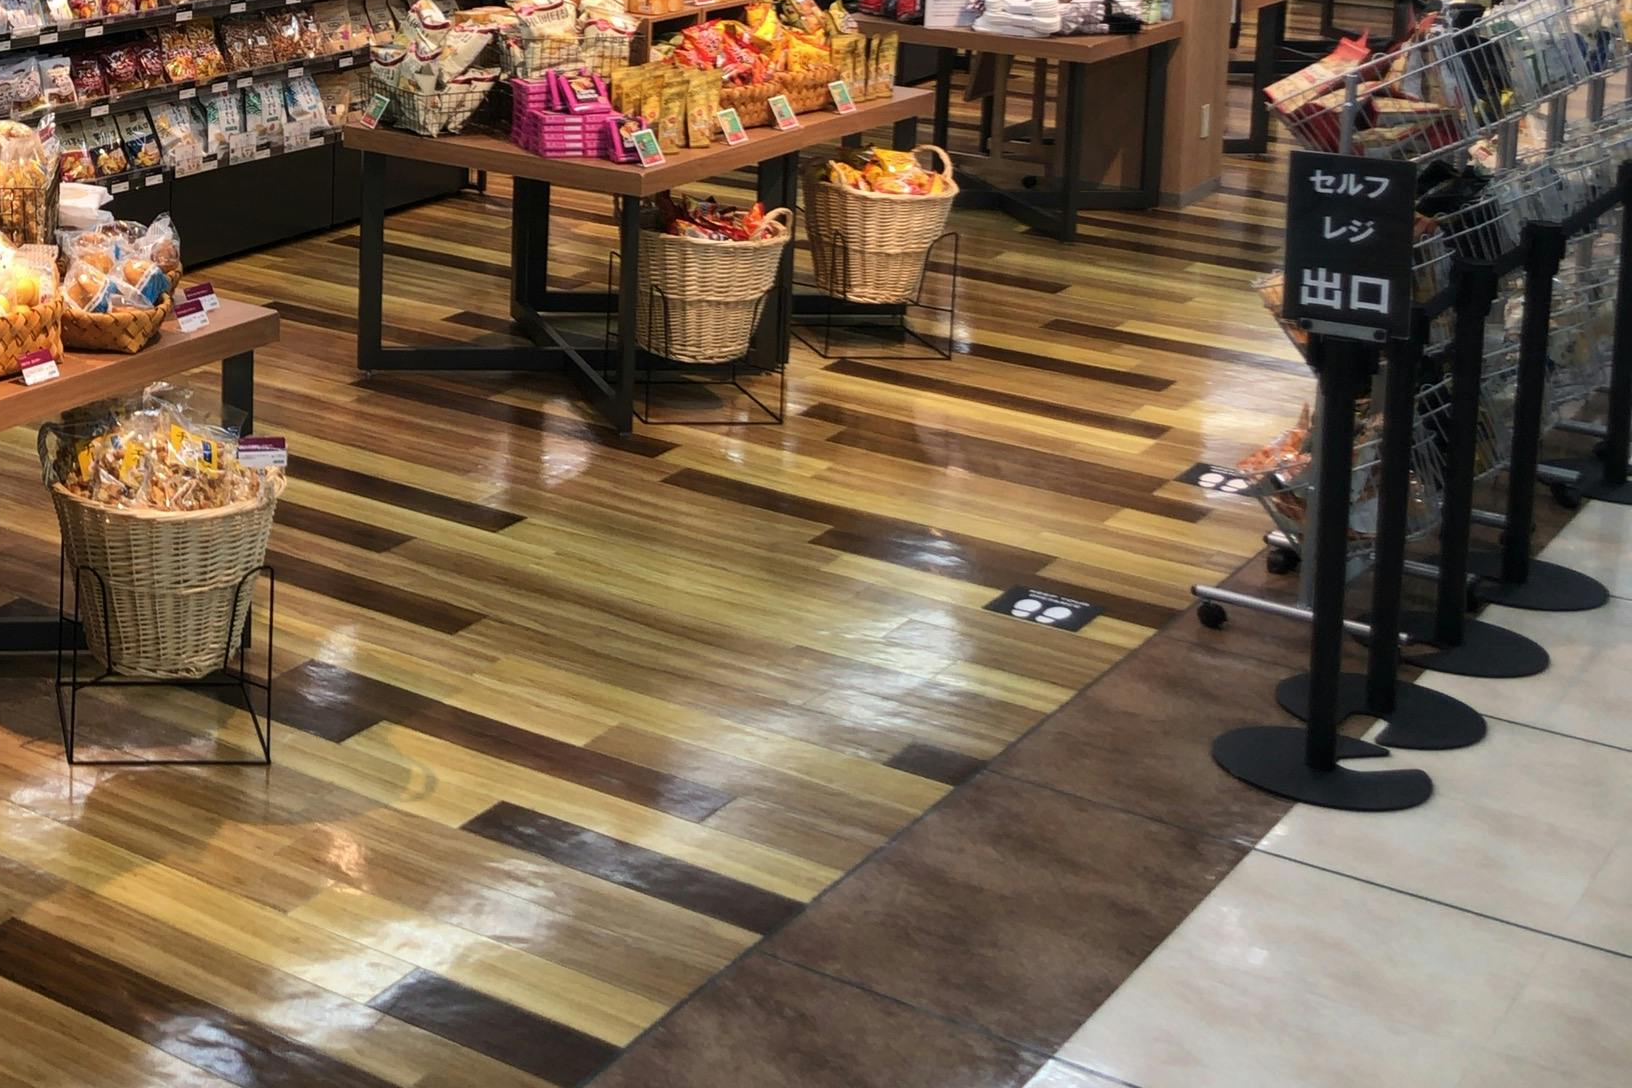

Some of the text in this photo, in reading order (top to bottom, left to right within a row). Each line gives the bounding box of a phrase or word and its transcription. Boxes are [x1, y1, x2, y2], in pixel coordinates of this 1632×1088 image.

[1309, 169, 1390, 198] セルフ
[1323, 216, 1376, 243] レジ
[1299, 268, 1390, 314] 出口
